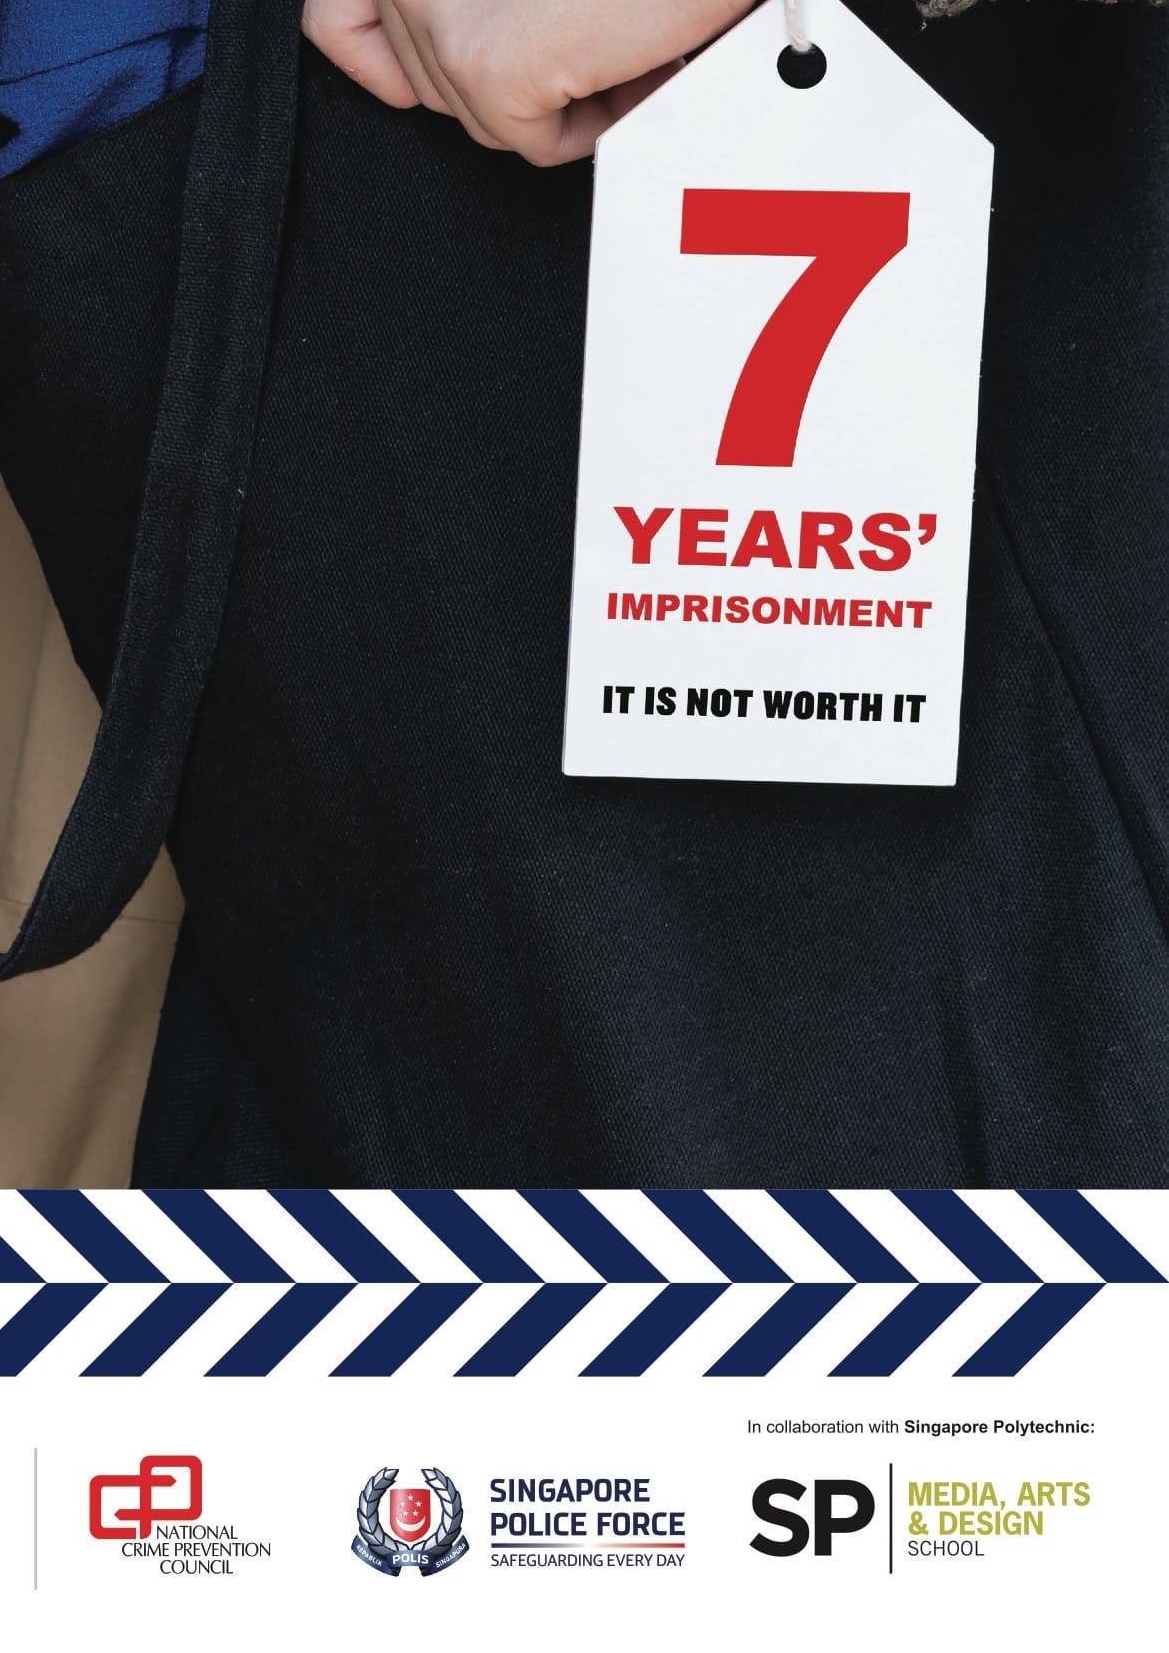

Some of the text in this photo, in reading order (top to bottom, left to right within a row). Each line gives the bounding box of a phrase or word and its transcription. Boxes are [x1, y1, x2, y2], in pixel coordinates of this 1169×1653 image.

[680, 187, 911, 467] 7
[613, 506, 938, 572] YEARS’
[607, 593, 932, 629] IMPRISONMENT
[602, 685, 927, 724] IT IS NOT WORTH IT
